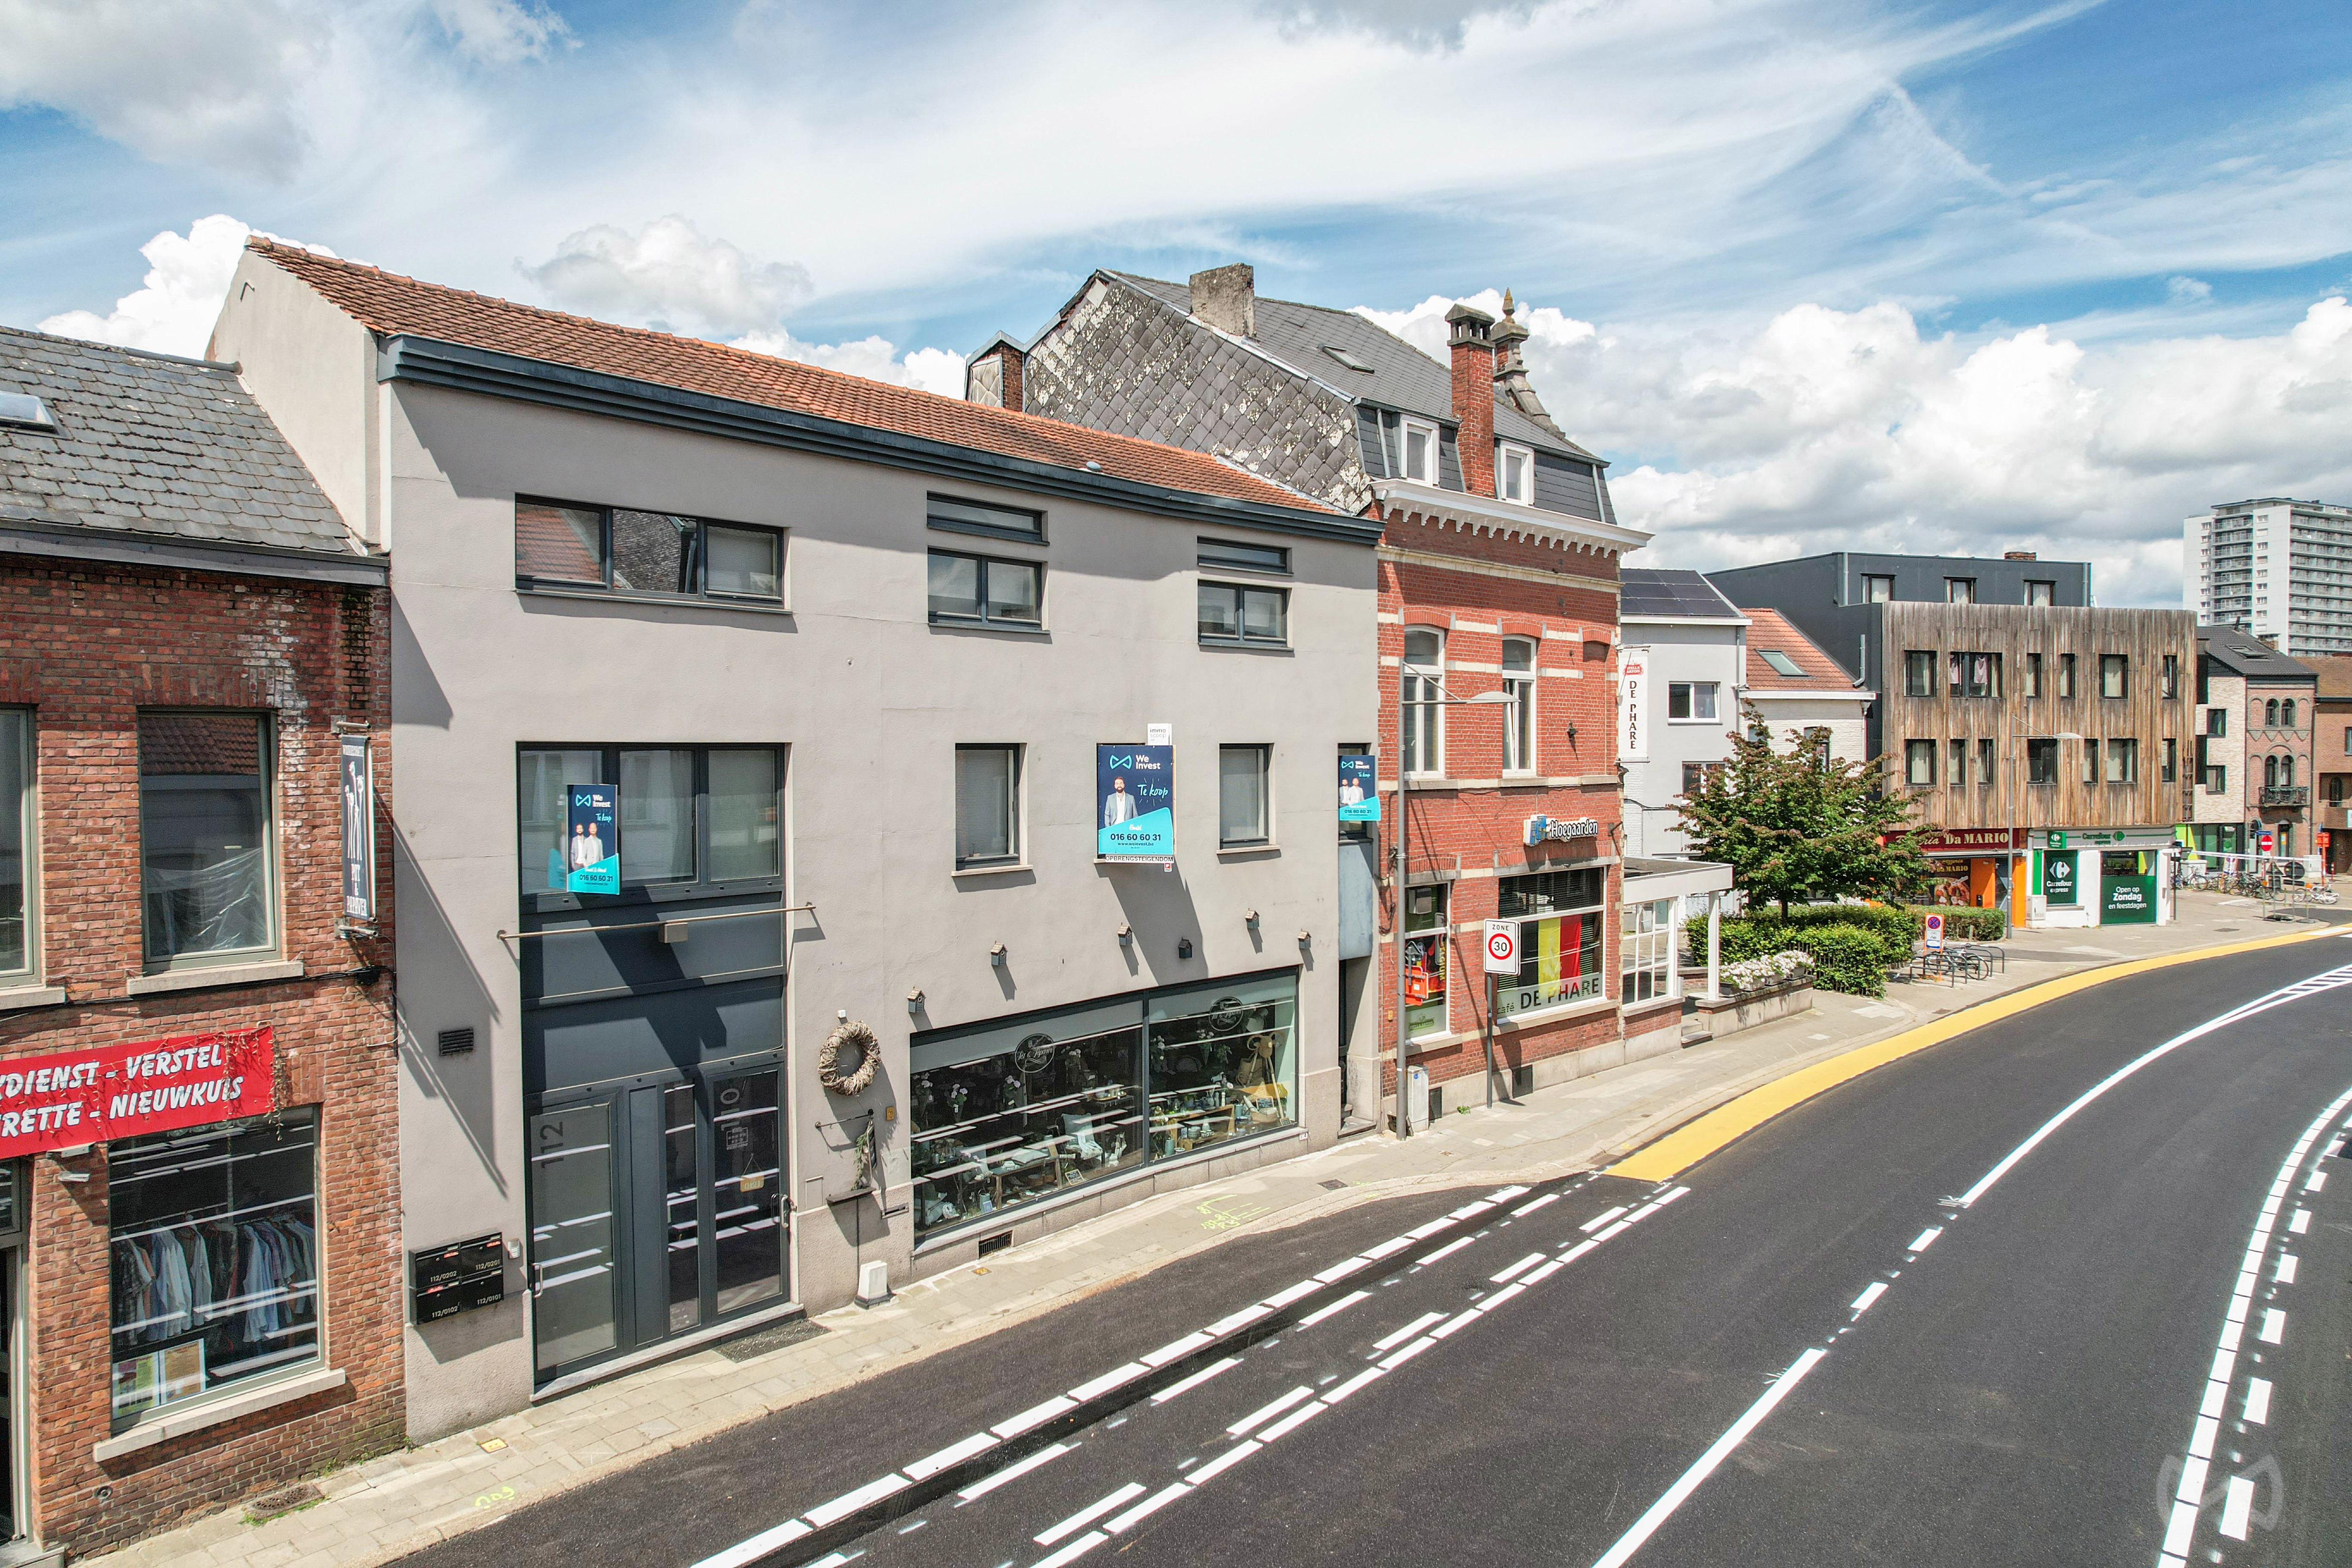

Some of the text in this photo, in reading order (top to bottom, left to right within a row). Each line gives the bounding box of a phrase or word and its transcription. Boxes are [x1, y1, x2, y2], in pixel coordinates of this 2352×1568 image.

[1629, 681, 1637, 698] DE
[1137, 783, 1168, 798] Te koop
[1550, 819, 1598, 841] Hoegaarden
[1945, 834, 1961, 844] Da
[1964, 832, 2009, 844] MARIO
[2113, 893, 2143, 901] Zondag
[1494, 941, 1507, 952] 30
[1521, 990, 1542, 1009] DE
[1548, 978, 1600, 1003] PHARE
[125, 1044, 223, 1080] VERSTEL
[0, 1101, 83, 1138] RETTE
[109, 1076, 244, 1120] NIEUWKUIS
[540, 1121, 564, 1168] 112
[475, 1259, 500, 1270] 112/0201
[430, 1271, 457, 1282] 112/0202
[477, 1294, 501, 1305] 112/0101
[432, 1306, 458, 1318] 112/0102
